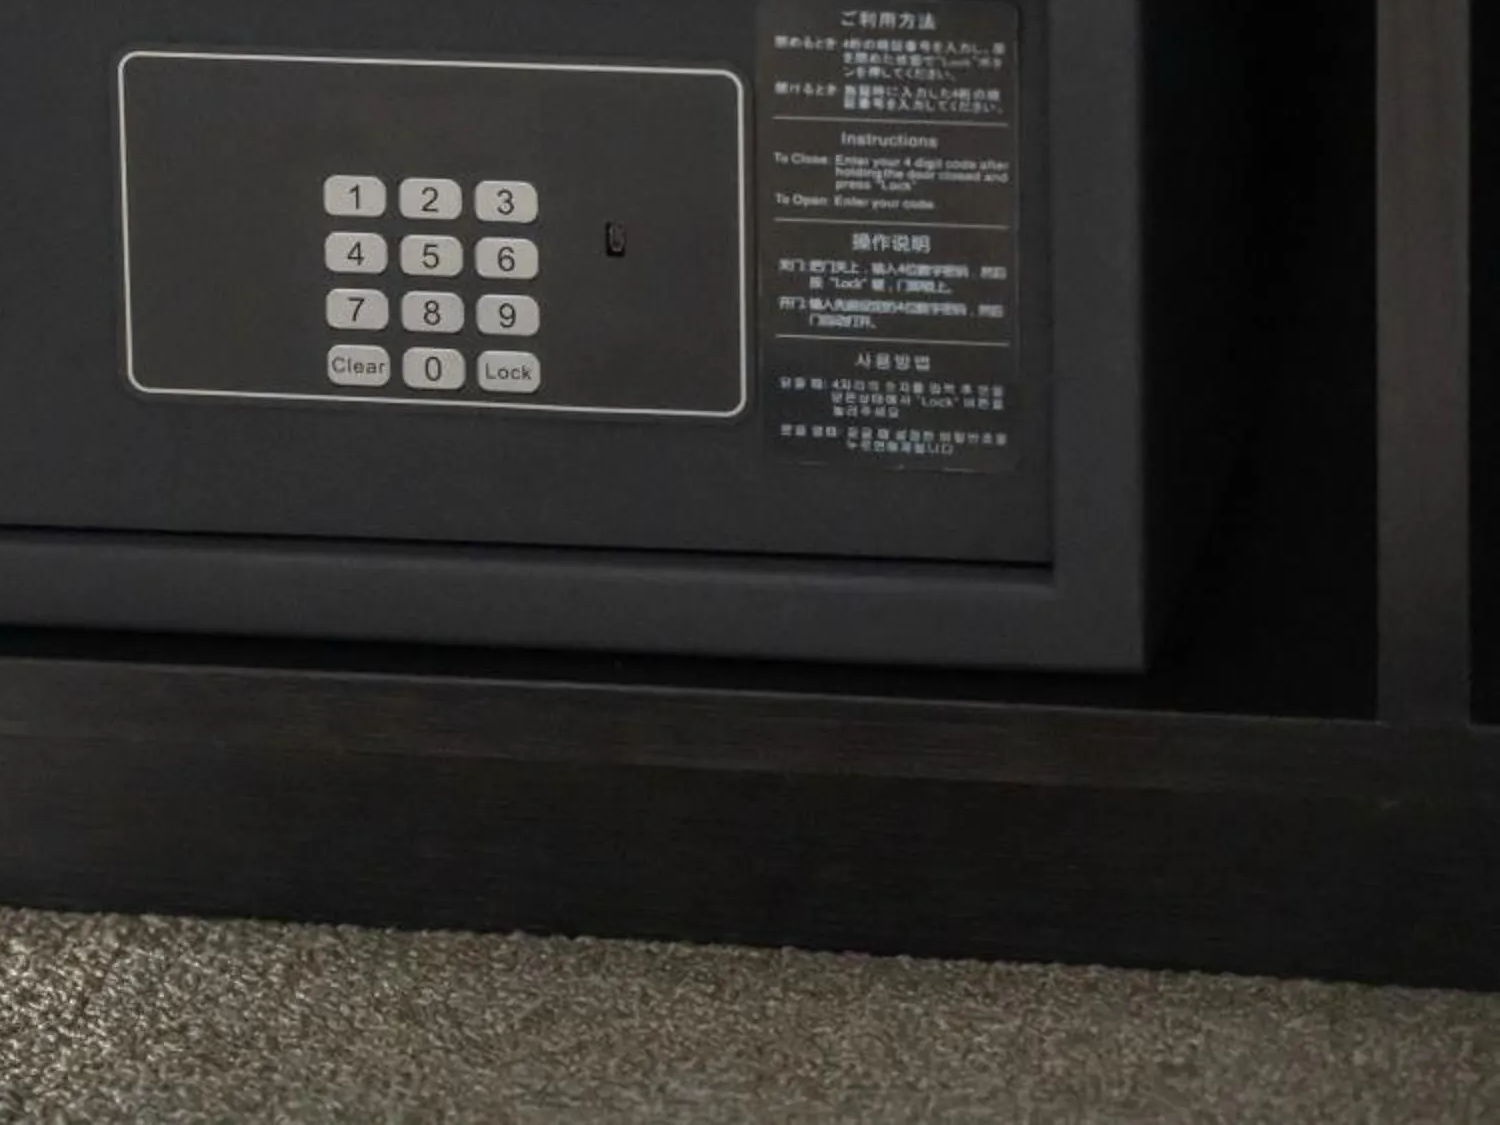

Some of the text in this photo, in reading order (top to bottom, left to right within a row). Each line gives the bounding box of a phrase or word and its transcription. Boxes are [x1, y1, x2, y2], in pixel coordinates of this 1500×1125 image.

[840, 10, 937, 30] ご利用方法
[840, 131, 939, 149] Instructions
[349, 184, 515, 216] 1 2 3
[347, 241, 515, 272] 4 5 6
[347, 297, 517, 328] 7 8 9
[331, 355, 533, 382] Clear 0 Lock
